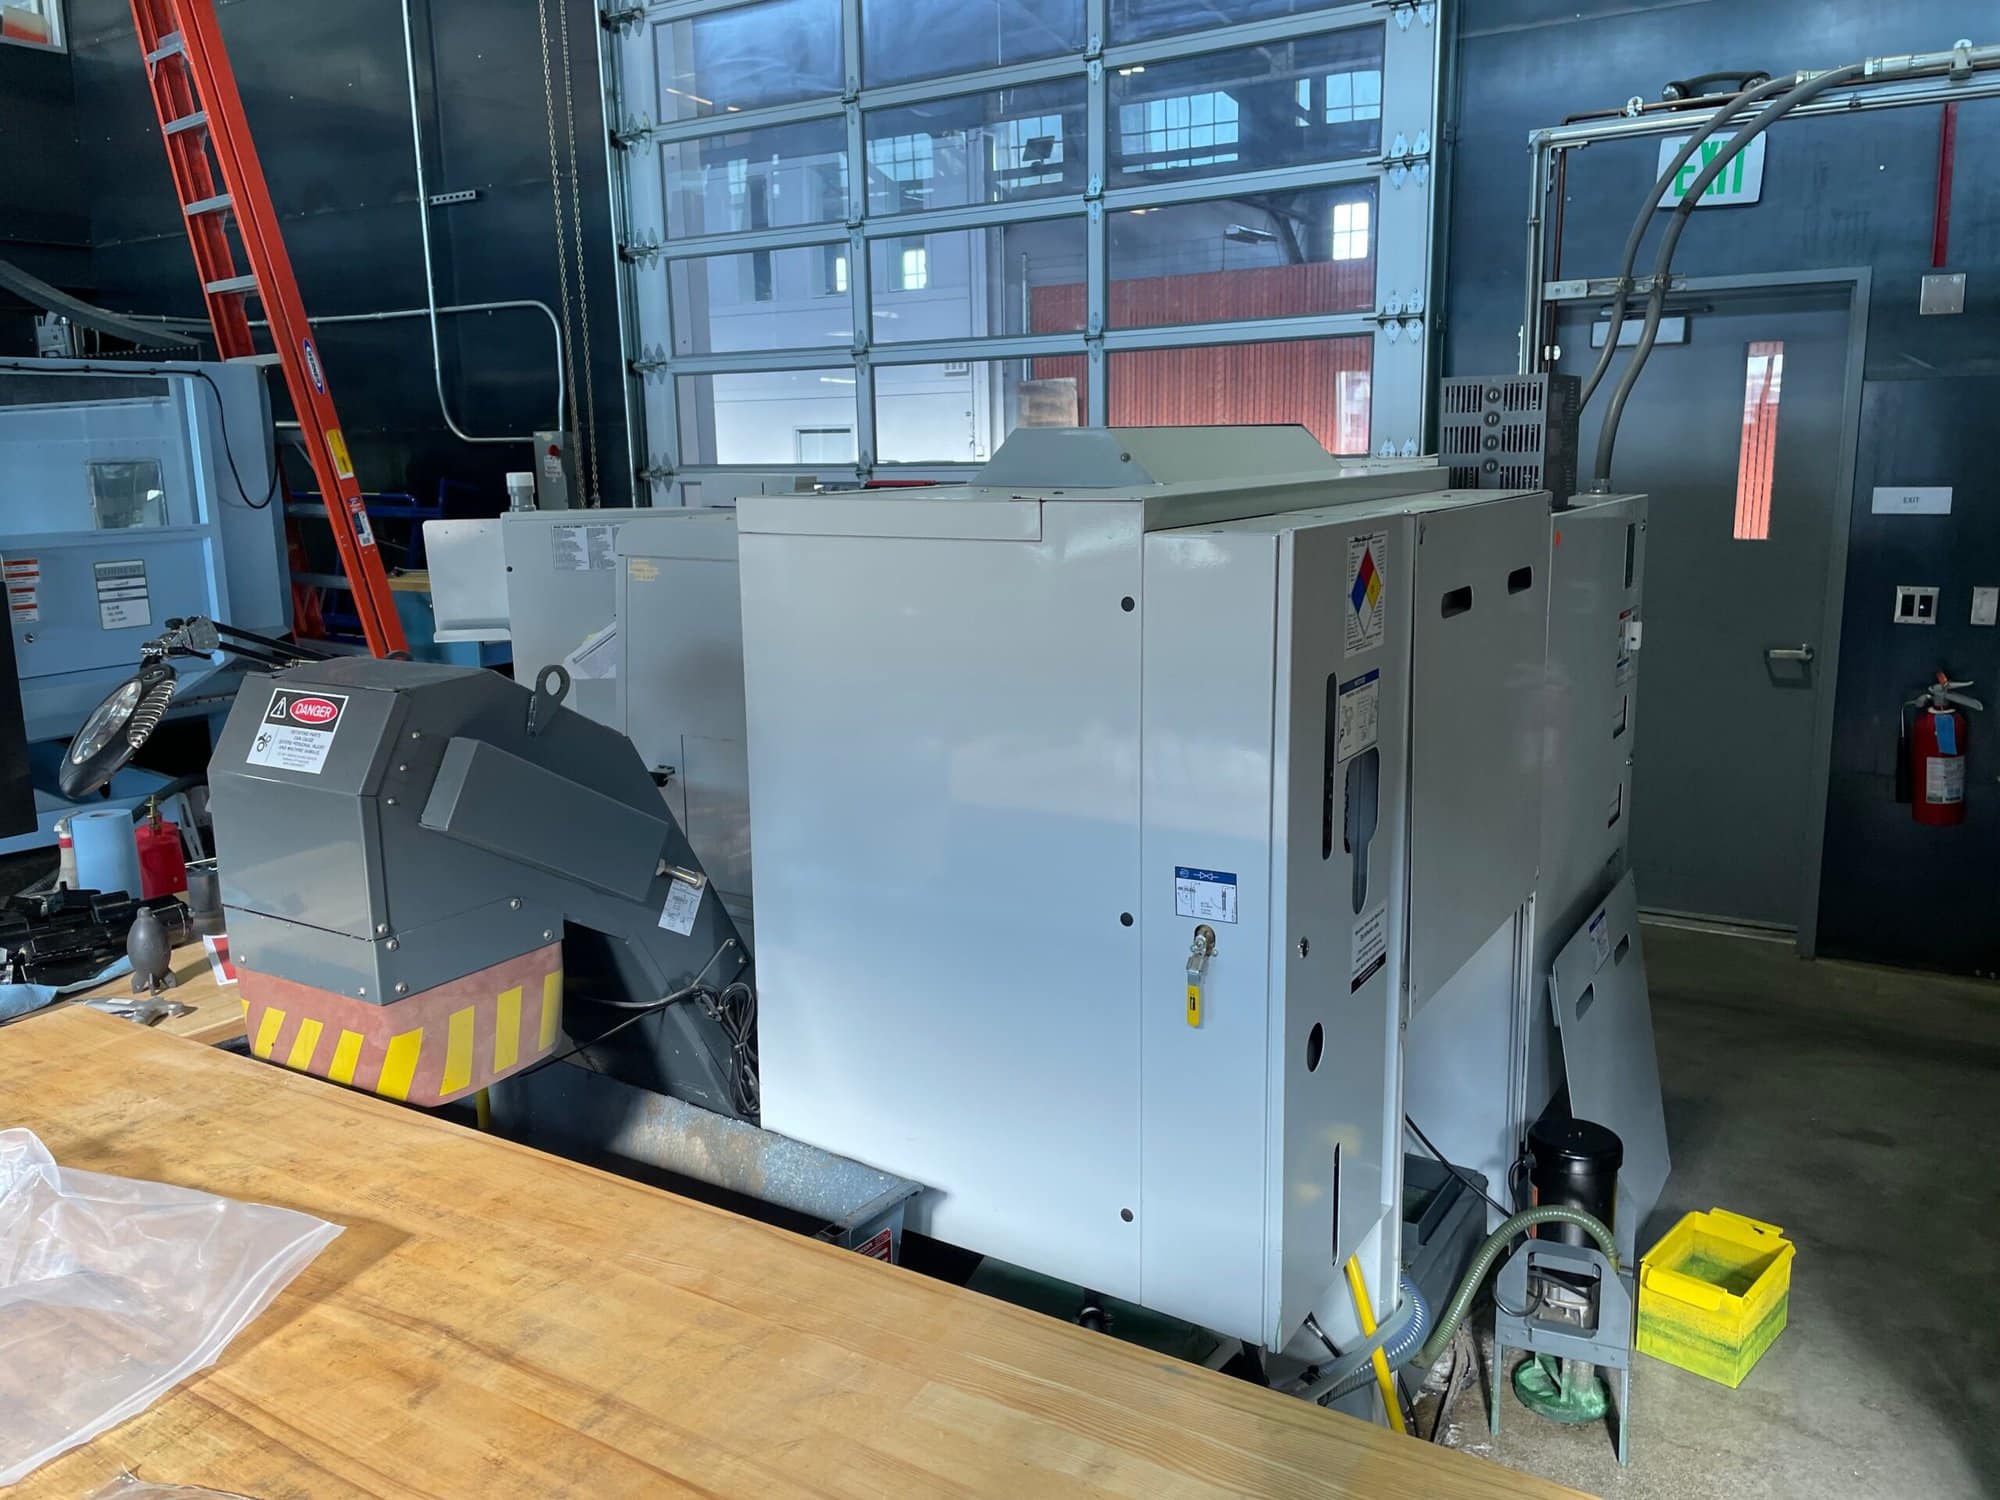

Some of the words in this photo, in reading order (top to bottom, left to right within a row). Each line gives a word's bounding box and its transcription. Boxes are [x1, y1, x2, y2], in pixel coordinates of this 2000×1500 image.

[1674, 141, 1751, 197] EXIT
[1903, 496, 1920, 505] EXIT
[295, 703, 332, 718] DANGER
